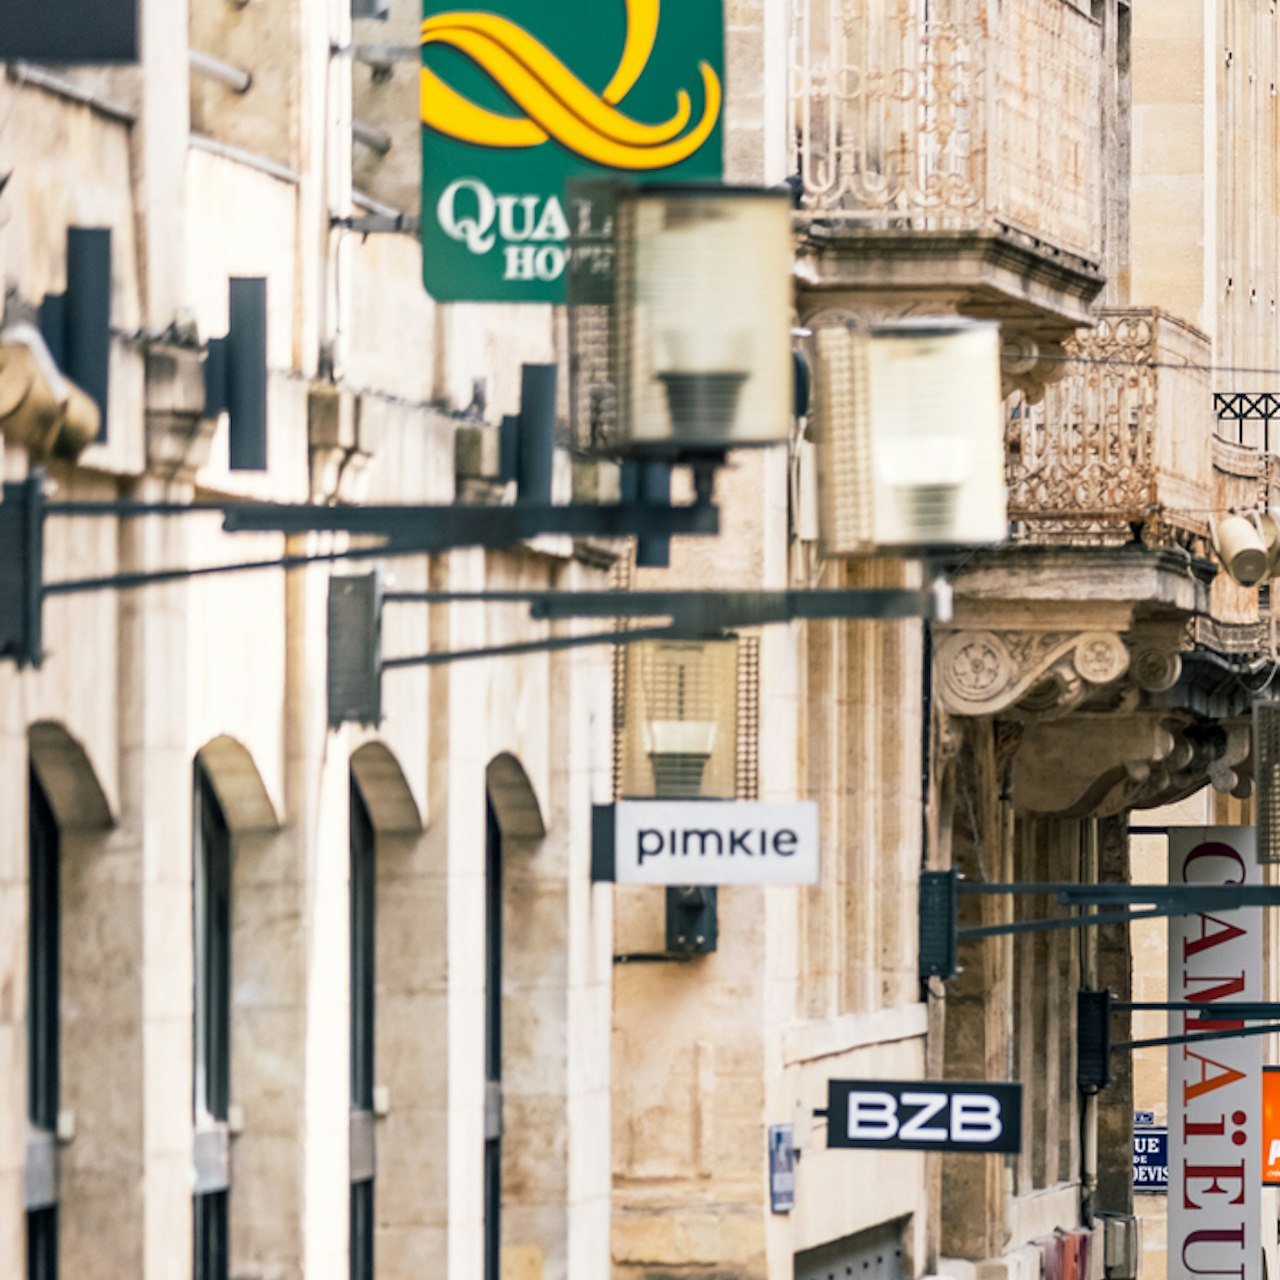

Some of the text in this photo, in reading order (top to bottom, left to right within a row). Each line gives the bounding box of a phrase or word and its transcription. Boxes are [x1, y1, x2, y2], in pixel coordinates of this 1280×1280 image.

[637, 824, 798, 865] pimkie
[847, 1091, 1003, 1143] BZB
[1133, 1138, 1161, 1153] UE
